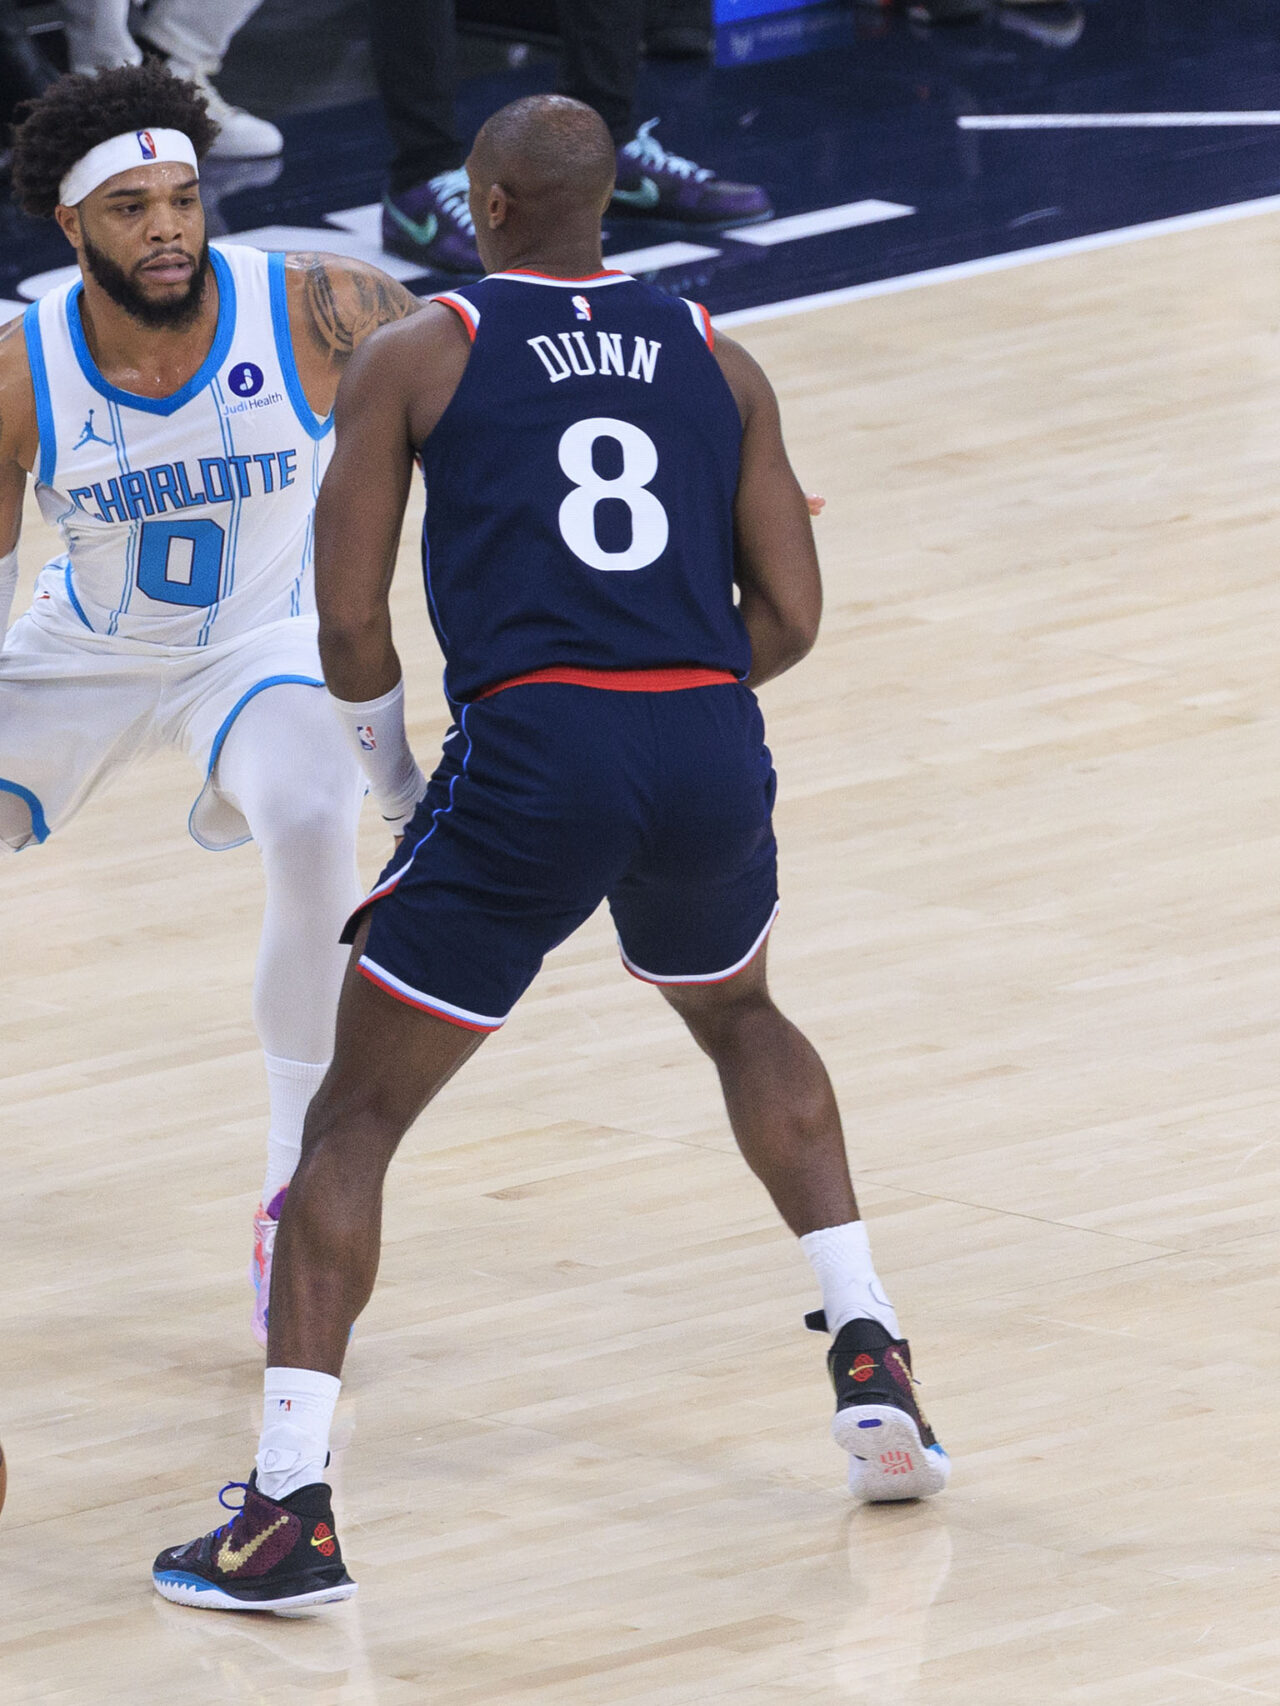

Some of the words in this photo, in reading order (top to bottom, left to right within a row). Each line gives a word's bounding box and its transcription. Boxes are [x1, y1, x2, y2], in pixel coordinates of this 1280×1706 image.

[526, 330, 662, 383] DUNN
[222, 401, 248, 416] Judi
[248, 392, 283, 410] Health
[67, 449, 297, 523] CHARLOTTE
[558, 417, 669, 571] 8
[136, 518, 225, 608] 0
